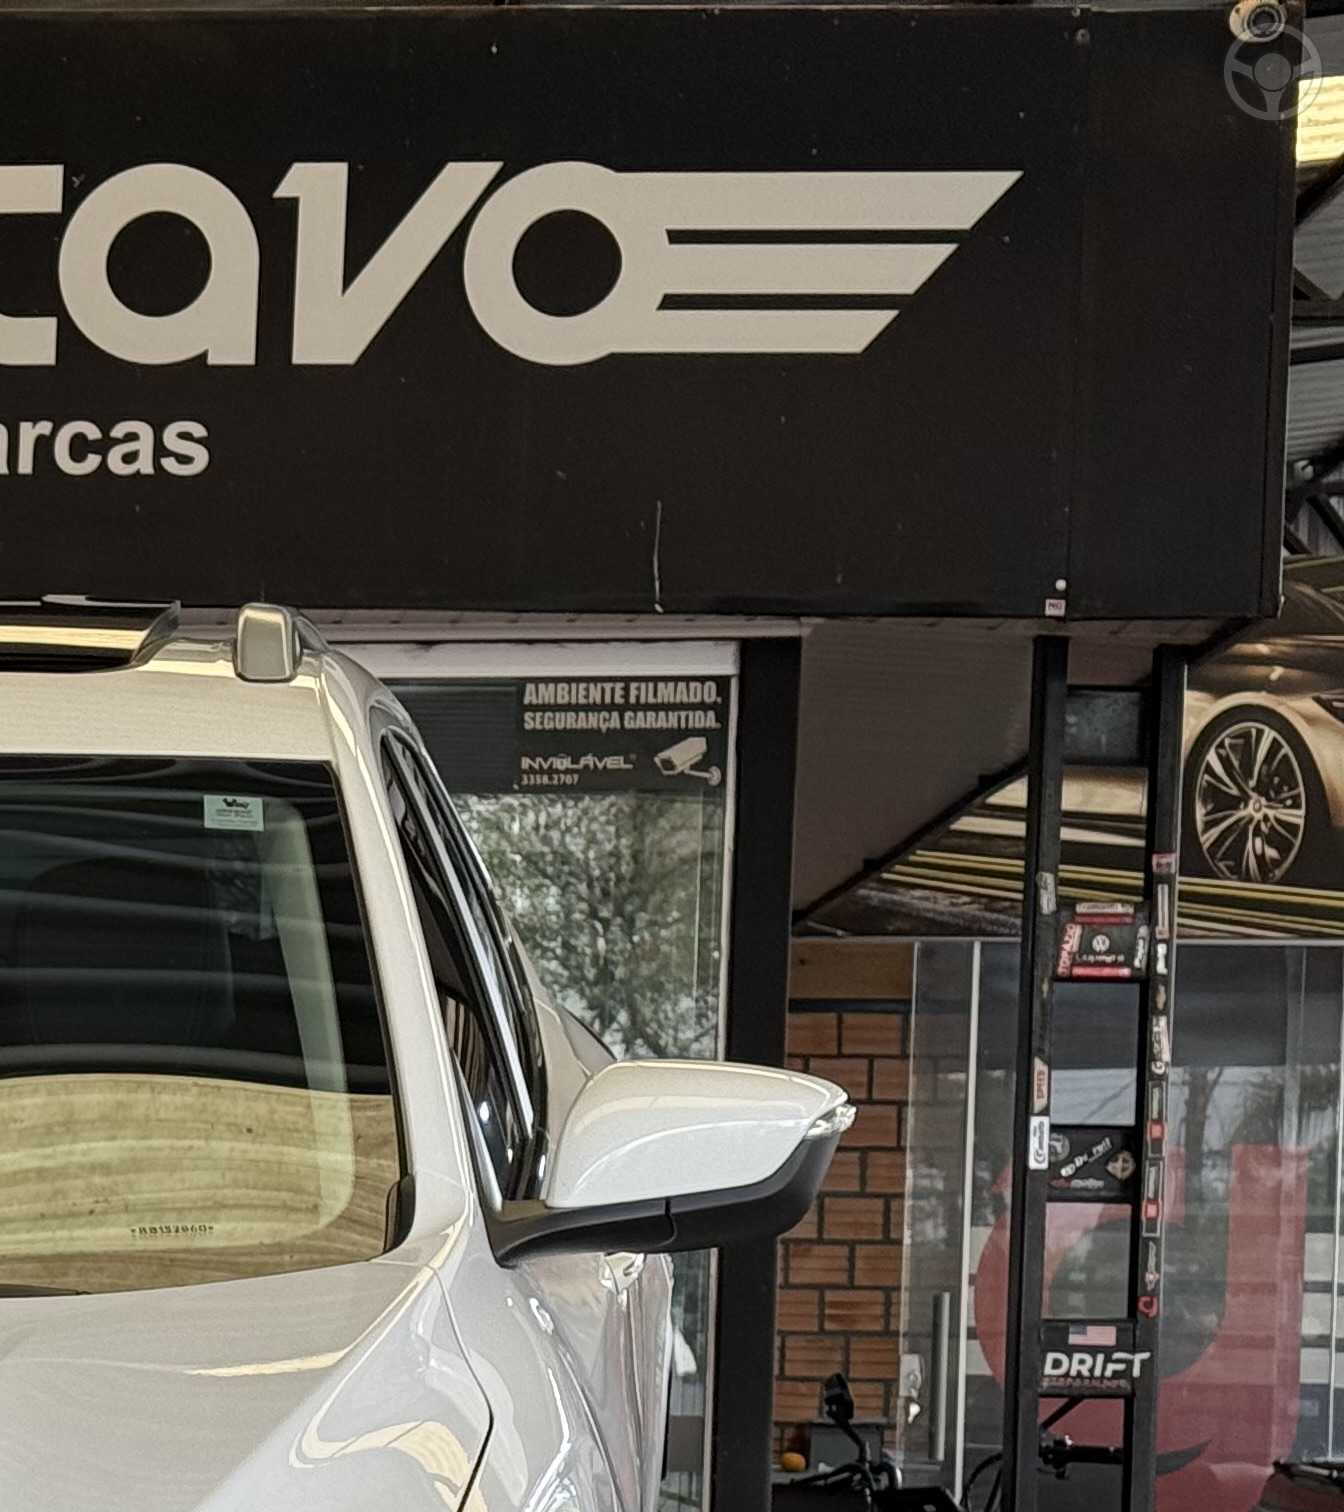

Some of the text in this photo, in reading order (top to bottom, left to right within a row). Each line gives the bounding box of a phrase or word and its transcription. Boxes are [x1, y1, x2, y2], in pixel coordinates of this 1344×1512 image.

[523, 681, 722, 705] AMBIENTE FILMADO.
[523, 709, 721, 733] SEGURANÇA GARANTIDA.
[1043, 1352, 1151, 1378] DRIFT
